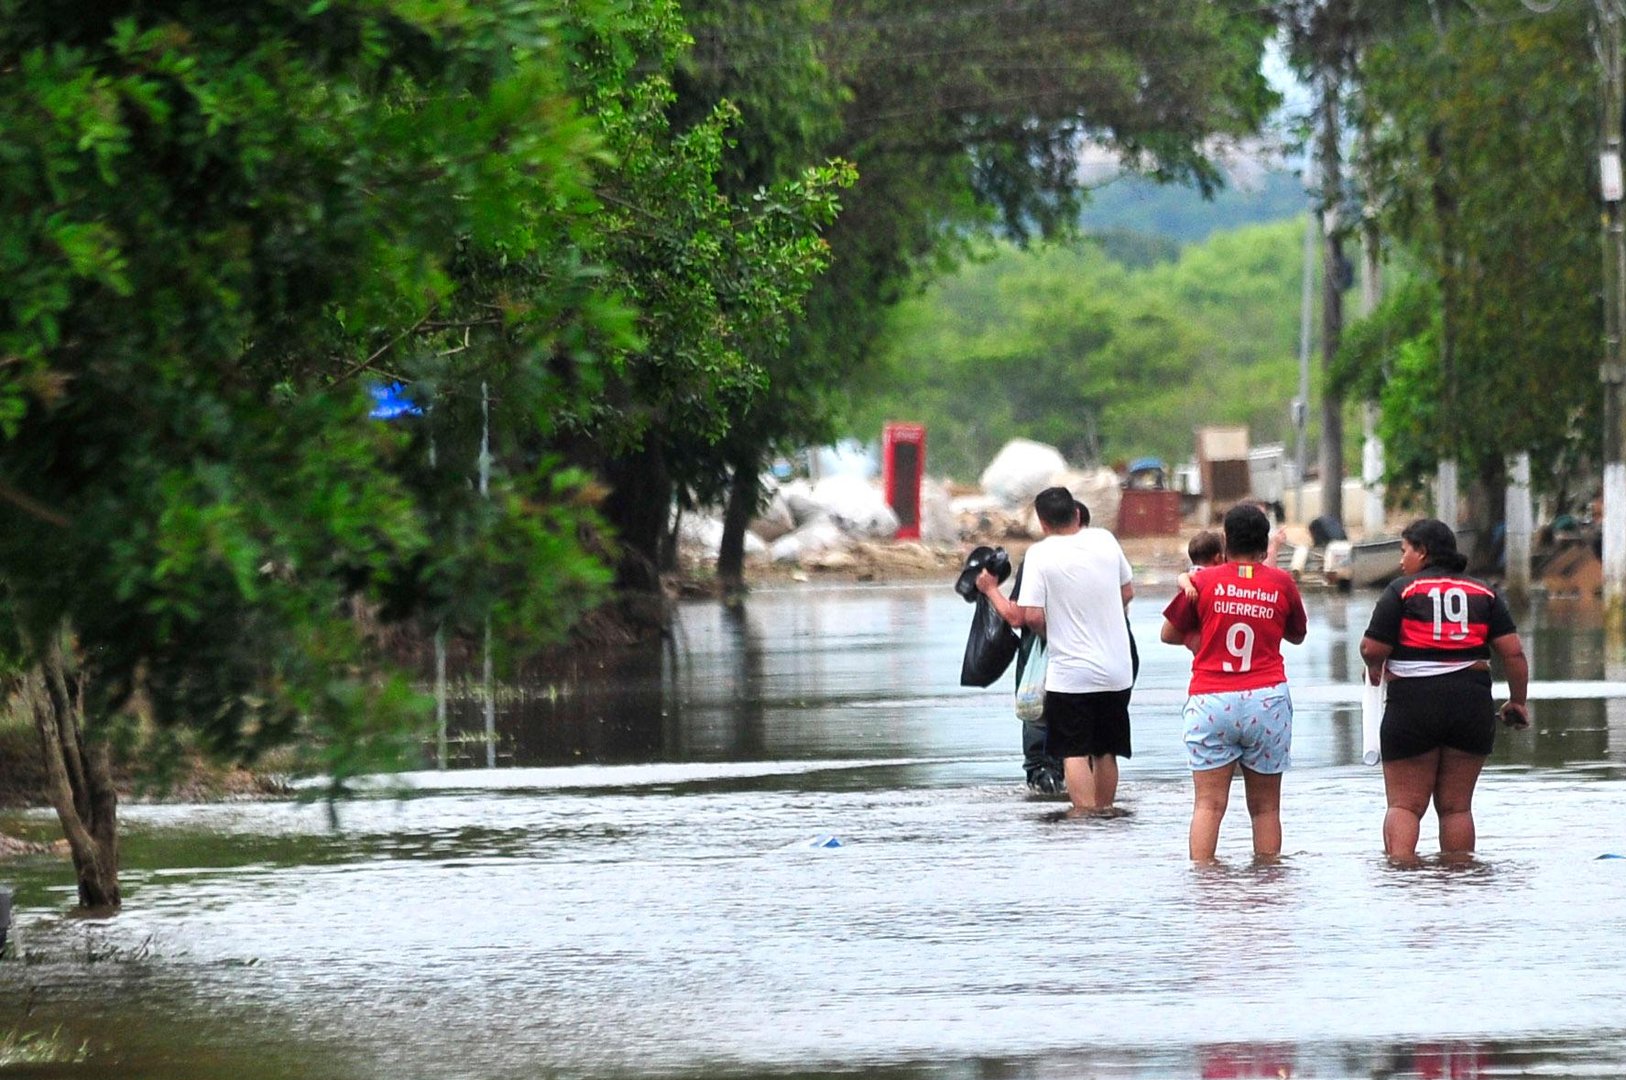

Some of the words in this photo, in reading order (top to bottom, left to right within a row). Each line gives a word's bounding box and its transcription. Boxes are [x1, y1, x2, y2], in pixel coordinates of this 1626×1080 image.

[1213, 601, 1274, 619] GUERRERO
[1226, 584, 1279, 604] Banrisul
[1427, 587, 1469, 640] 19
[1222, 622, 1255, 672] 9
